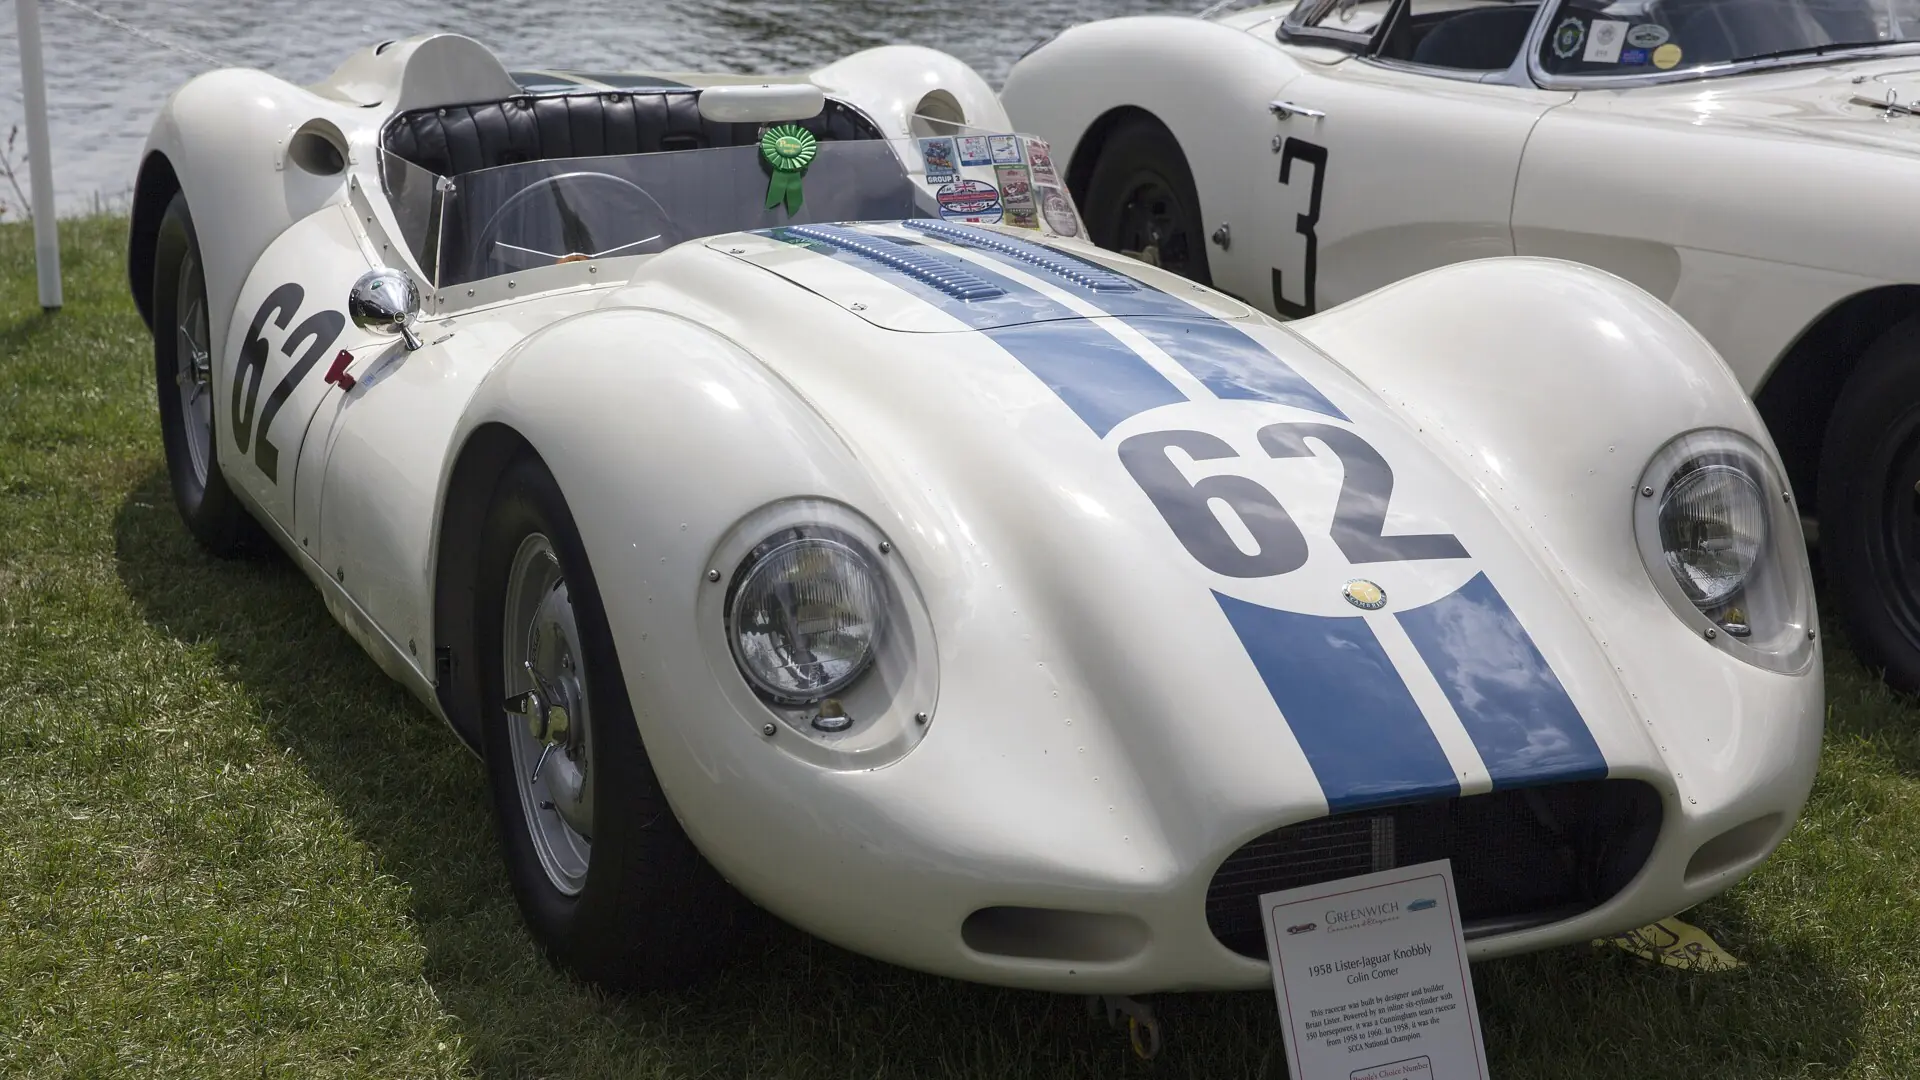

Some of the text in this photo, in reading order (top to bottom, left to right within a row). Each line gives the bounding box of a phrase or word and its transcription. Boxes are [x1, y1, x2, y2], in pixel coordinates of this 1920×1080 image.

[927, 175, 952, 184] GROUP
[1272, 136, 1328, 319] 3
[231, 282, 346, 486] 62
[1118, 421, 1472, 579] 62
[1308, 942, 1432, 978] 1958 Lister-Jaguar Knobbly
[1347, 966, 1399, 985] Colin Comer
[1305, 1020, 1322, 1029] Brian
[1343, 1011, 1368, 1022] Powered
[1369, 1008, 1376, 1016] by
[1387, 1003, 1404, 1012] inline
[1440, 992, 1453, 1001] with
[1310, 1009, 1324, 1018] This
[1325, 1006, 1346, 1015] racecar
[1361, 996, 1375, 1008] built
[1376, 996, 1383, 1005] by
[1384, 991, 1410, 1002] designer
[1412, 988, 1422, 996] and
[1423, 984, 1445, 994] builder
[1380, 1011, 1418, 1024] Cunningham
[1419, 1008, 1434, 1016] team
[1435, 1003, 1456, 1013] racecar
[1326, 1037, 1342, 1047] from
[1343, 1035, 1358, 1044] 1958
[1430, 1016, 1440, 1024] the
[1348, 1044, 1364, 1054] SCCA
[1364, 1038, 1389, 1049] National
[1378, 1068, 1402, 1079] Choice
[1402, 1062, 1429, 1074] Number
